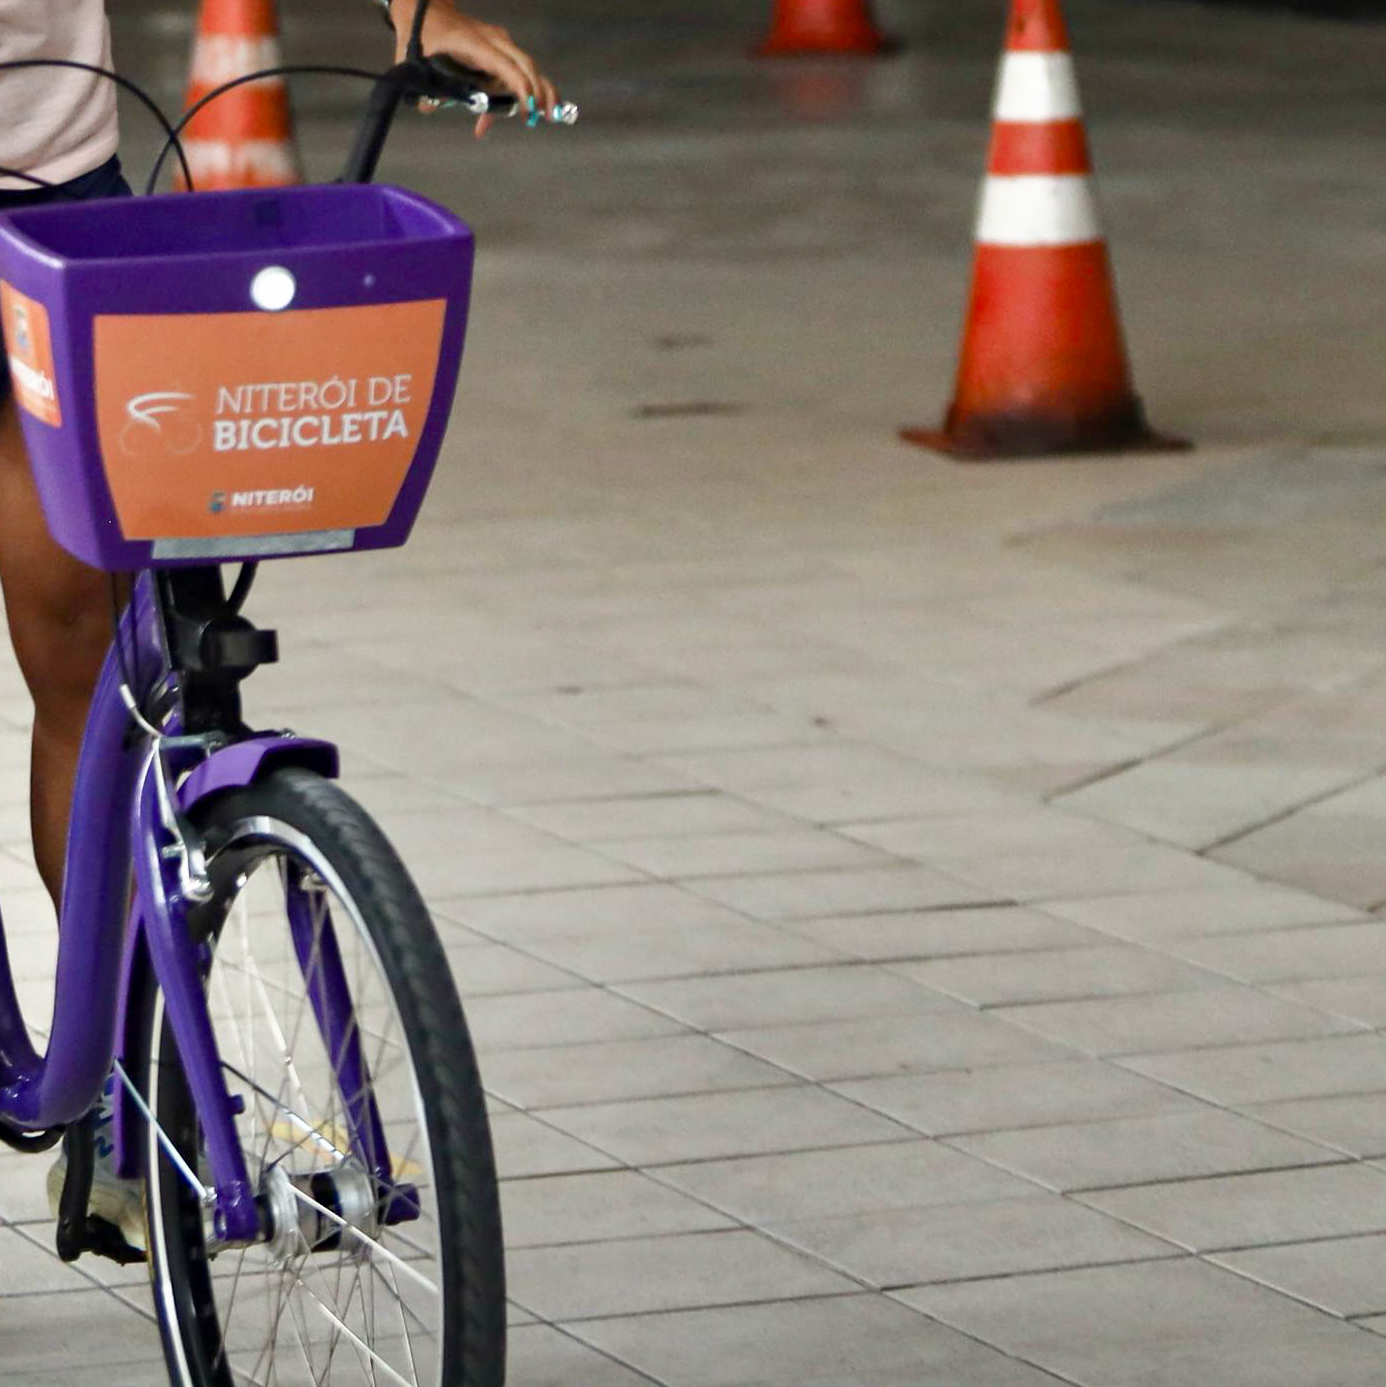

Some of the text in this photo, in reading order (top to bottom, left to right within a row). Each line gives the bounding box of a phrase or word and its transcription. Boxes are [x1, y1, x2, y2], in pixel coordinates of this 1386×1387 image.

[215, 374, 412, 414] NITERÓI DE
[214, 409, 409, 452] BICICLETA
[231, 485, 314, 507] NITERÓI
